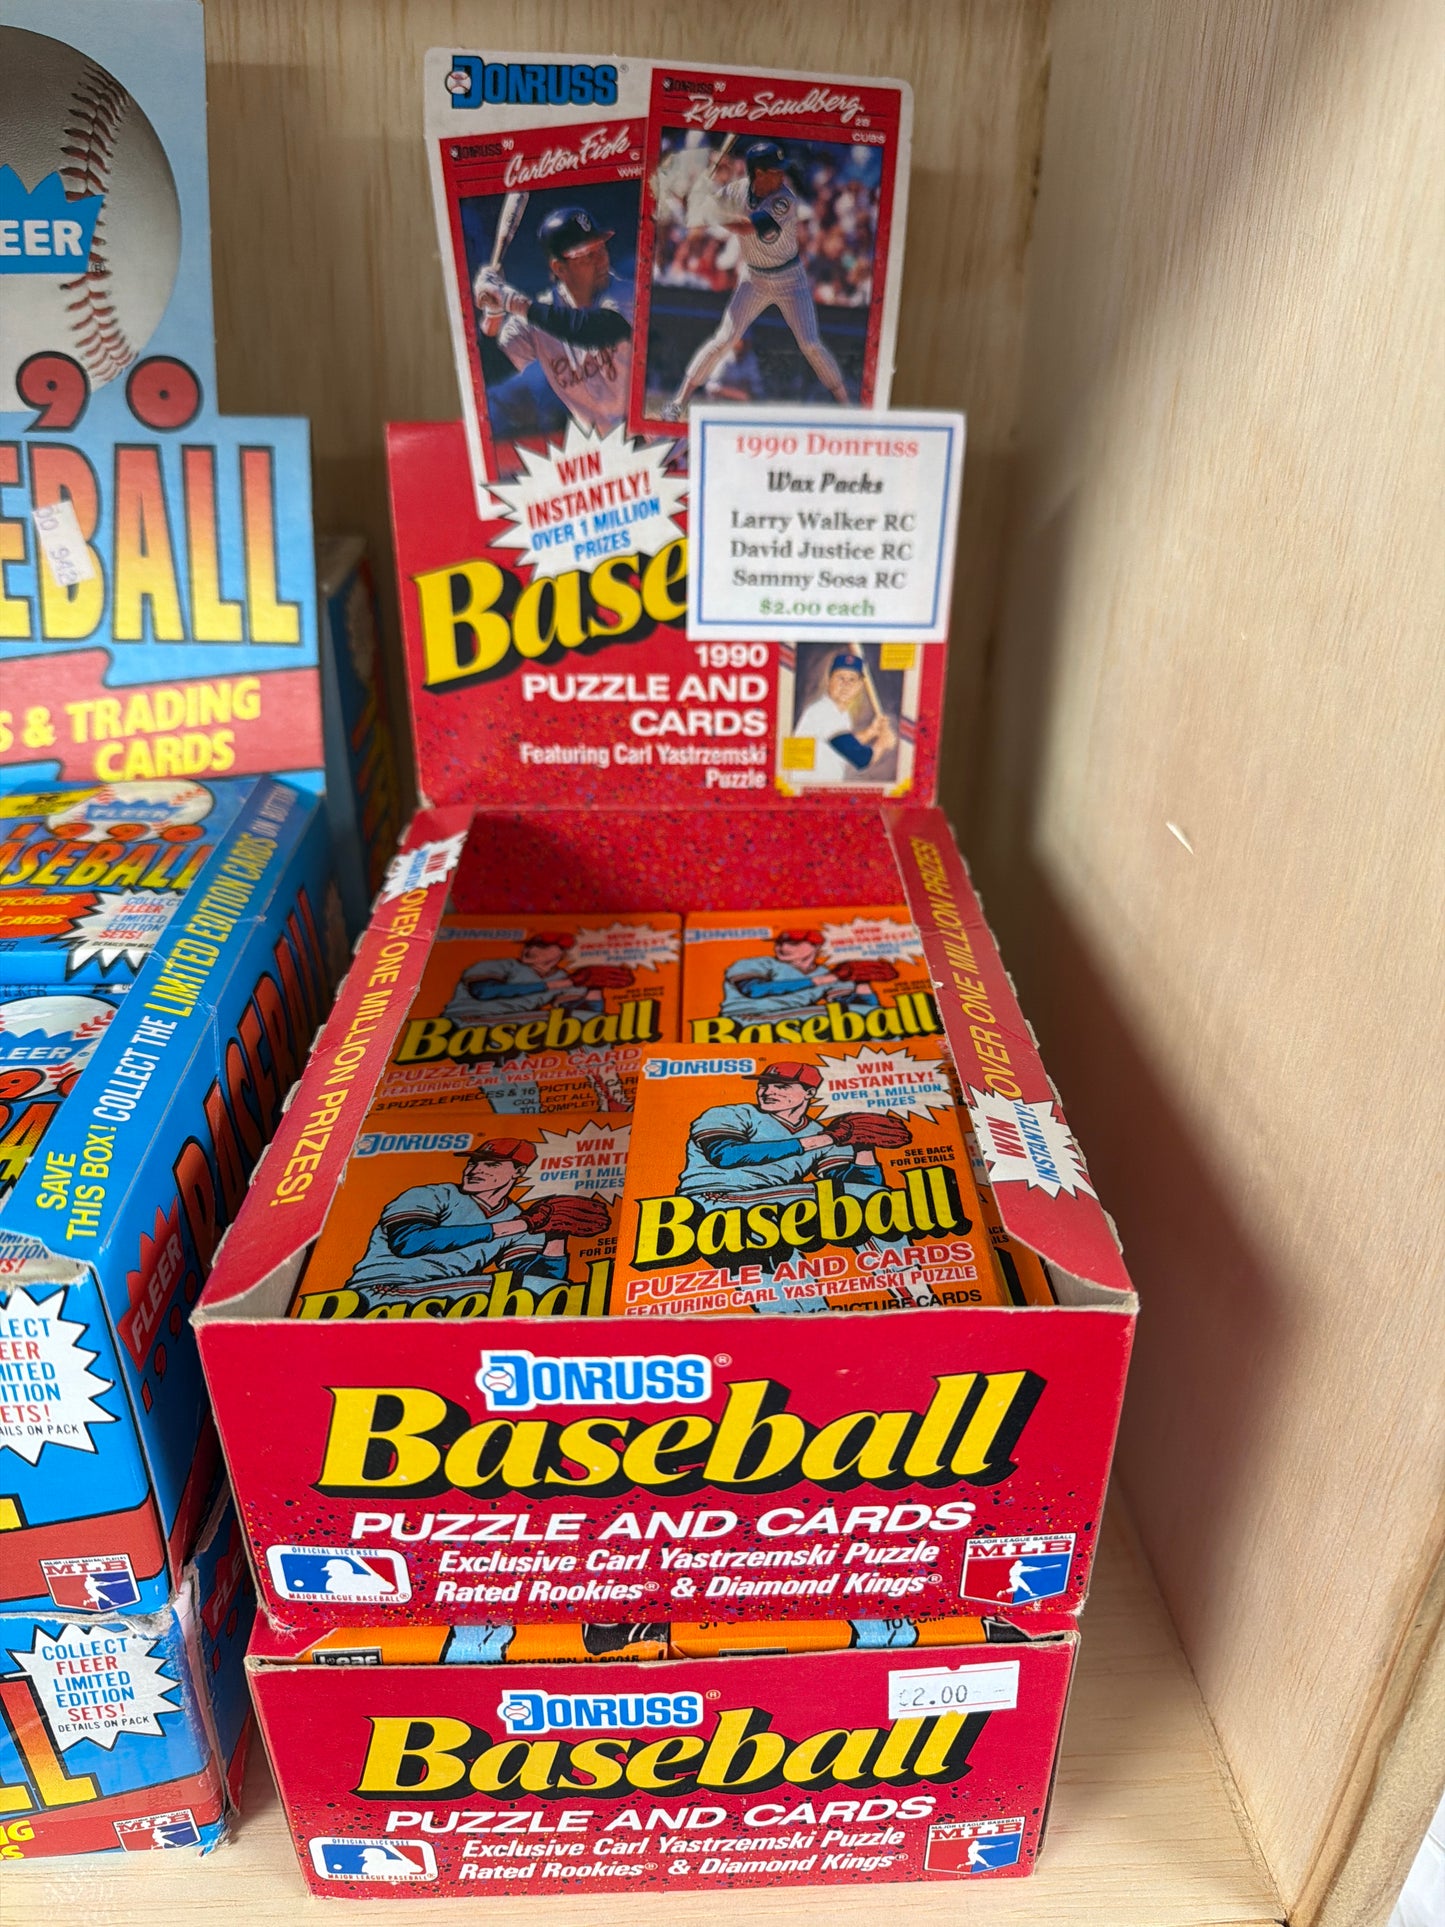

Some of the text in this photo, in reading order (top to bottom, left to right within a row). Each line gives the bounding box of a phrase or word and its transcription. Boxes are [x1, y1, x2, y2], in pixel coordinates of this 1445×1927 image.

[445, 55, 617, 109] DONRUSS
[683, 88, 864, 130] Ryne Sandberg
[852, 132, 886, 144] CUBS
[503, 127, 632, 188] Carlton Fisk
[0, 219, 84, 258] EER
[736, 433, 919, 458] 1990 Donruss
[556, 451, 602, 486] WIN
[767, 470, 884, 494] Wax Packs
[527, 477, 652, 529] INSTANTLY!
[531, 497, 661, 552] OVER 1 MILLION
[731, 510, 916, 533] Larry Walker RC
[0, 440, 303, 645] EBALL
[573, 531, 632, 562] PRIZES
[730, 540, 913, 561] David Justice RC
[732, 569, 907, 591] Sammy Sosa RC
[412, 537, 688, 692] Base
[759, 597, 875, 616] $2.00 each
[696, 645, 768, 668] 1990
[522, 676, 768, 701] PUZZLE AND
[23, 707, 56, 749] &
[66, 677, 261, 743] TRADING
[631, 709, 768, 737] CARDS
[94, 731, 236, 783] CARDS
[521, 744, 767, 769] Featuring Carl Yastrzemski
[706, 769, 766, 789] Puzzle
[0, 839, 215, 890] ASEBALL
[219, 833, 279, 881] CARDS
[113, 915, 167, 923] LIMITED
[118, 905, 165, 914] FLEER
[184, 876, 257, 955] EDITION
[389, 887, 430, 941] OVER
[98, 931, 144, 940] SETS!
[106, 923, 164, 932] EDITION
[932, 894, 981, 976] MILLION
[367, 942, 407, 987] ONE
[145, 938, 220, 1018] LIMITED
[951, 971, 996, 1026] ONE
[130, 1016, 178, 1050] THE
[325, 987, 394, 1086] MILLION
[394, 999, 661, 1064] Baseball
[0, 1046, 72, 1060] LEER
[969, 1024, 1023, 1099] OVER
[385, 1049, 641, 1085] PUZZLE AND CARD
[643, 1057, 755, 1080] DONRUSS
[856, 1061, 895, 1075] WIN
[93, 1046, 161, 1123] COLLECT
[828, 1070, 935, 1091] INSTANTLY!
[831, 1083, 942, 1103] OVER 1 MILLION
[387, 1096, 448, 1110] PUZZLE
[451, 1089, 506, 1103] PIECES
[866, 1095, 917, 1108] PRIZES
[270, 1087, 350, 1208] PRIZES!
[356, 1132, 472, 1155] DONRUSS
[577, 1138, 615, 1153] WIN
[986, 1115, 1027, 1160] WIN
[1014, 1102, 1062, 1185] INSTANTLY!
[80, 1124, 118, 1180] BOX!
[540, 1151, 628, 1170] INSTANT
[889, 1153, 955, 1167] FOR DETAILS
[904, 1145, 954, 1157] SEE BACK
[36, 1151, 77, 1210] SAVE
[540, 1168, 590, 1182] OVER 1
[574, 1177, 625, 1191] PRIZES
[66, 1183, 107, 1241] THIS
[631, 1165, 971, 1272] Baseball
[579, 1247, 603, 1258] FOR
[597, 1238, 618, 1247] SEE
[627, 1242, 974, 1302] PUZZLE AND CARDS
[130, 1231, 182, 1355] FLEER
[627, 1265, 977, 1316] FEATURING CARL YASTRZEMSKI PUZZLE
[916, 1289, 983, 1308] CARDS
[0, 1341, 41, 1360] EER
[0, 1382, 61, 1402] ITION
[478, 1352, 708, 1409] DONRUSS
[0, 1404, 51, 1424] ETS!
[28, 1423, 80, 1435] ON PACK
[312, 1369, 1042, 1498] Baseball
[351, 1501, 977, 1541] PUZZLE AND CARDS
[968, 1533, 1073, 1545] MAJOR LEAGUE BASEBALL
[968, 1540, 1072, 1558] MLB
[291, 1546, 379, 1558] OFFICIAL LICENSEE
[439, 1541, 940, 1573] Exclusive Carl Yastrzemski Puzzle
[44, 1560, 128, 1576] MLB
[289, 1593, 400, 1603] MAJOR LEAGUE BASEBALL
[436, 1580, 520, 1603] Rated
[670, 1578, 698, 1598] &
[706, 1572, 841, 1598] Diamond
[42, 1638, 128, 1661] COLLECT
[56, 1656, 119, 1675] FLEER
[53, 1671, 131, 1693] LIMITED
[56, 1686, 135, 1708] EDITION
[58, 1716, 150, 1733] DETAILS ON PACK
[67, 1703, 126, 1722] SETS!
[499, 1691, 701, 1733] DONRUSS
[350, 1706, 990, 1800] Baseball
[116, 1813, 191, 1833] MLB
[386, 1796, 937, 1833] PUZZLE AND CARDS
[931, 1821, 1022, 1840] MLB
[463, 1829, 906, 1859] Exclusive Carl Yastrzemski Puzzle
[459, 1862, 535, 1881] Rated
[669, 1859, 689, 1875] &
[701, 1855, 818, 1875] Diamond
